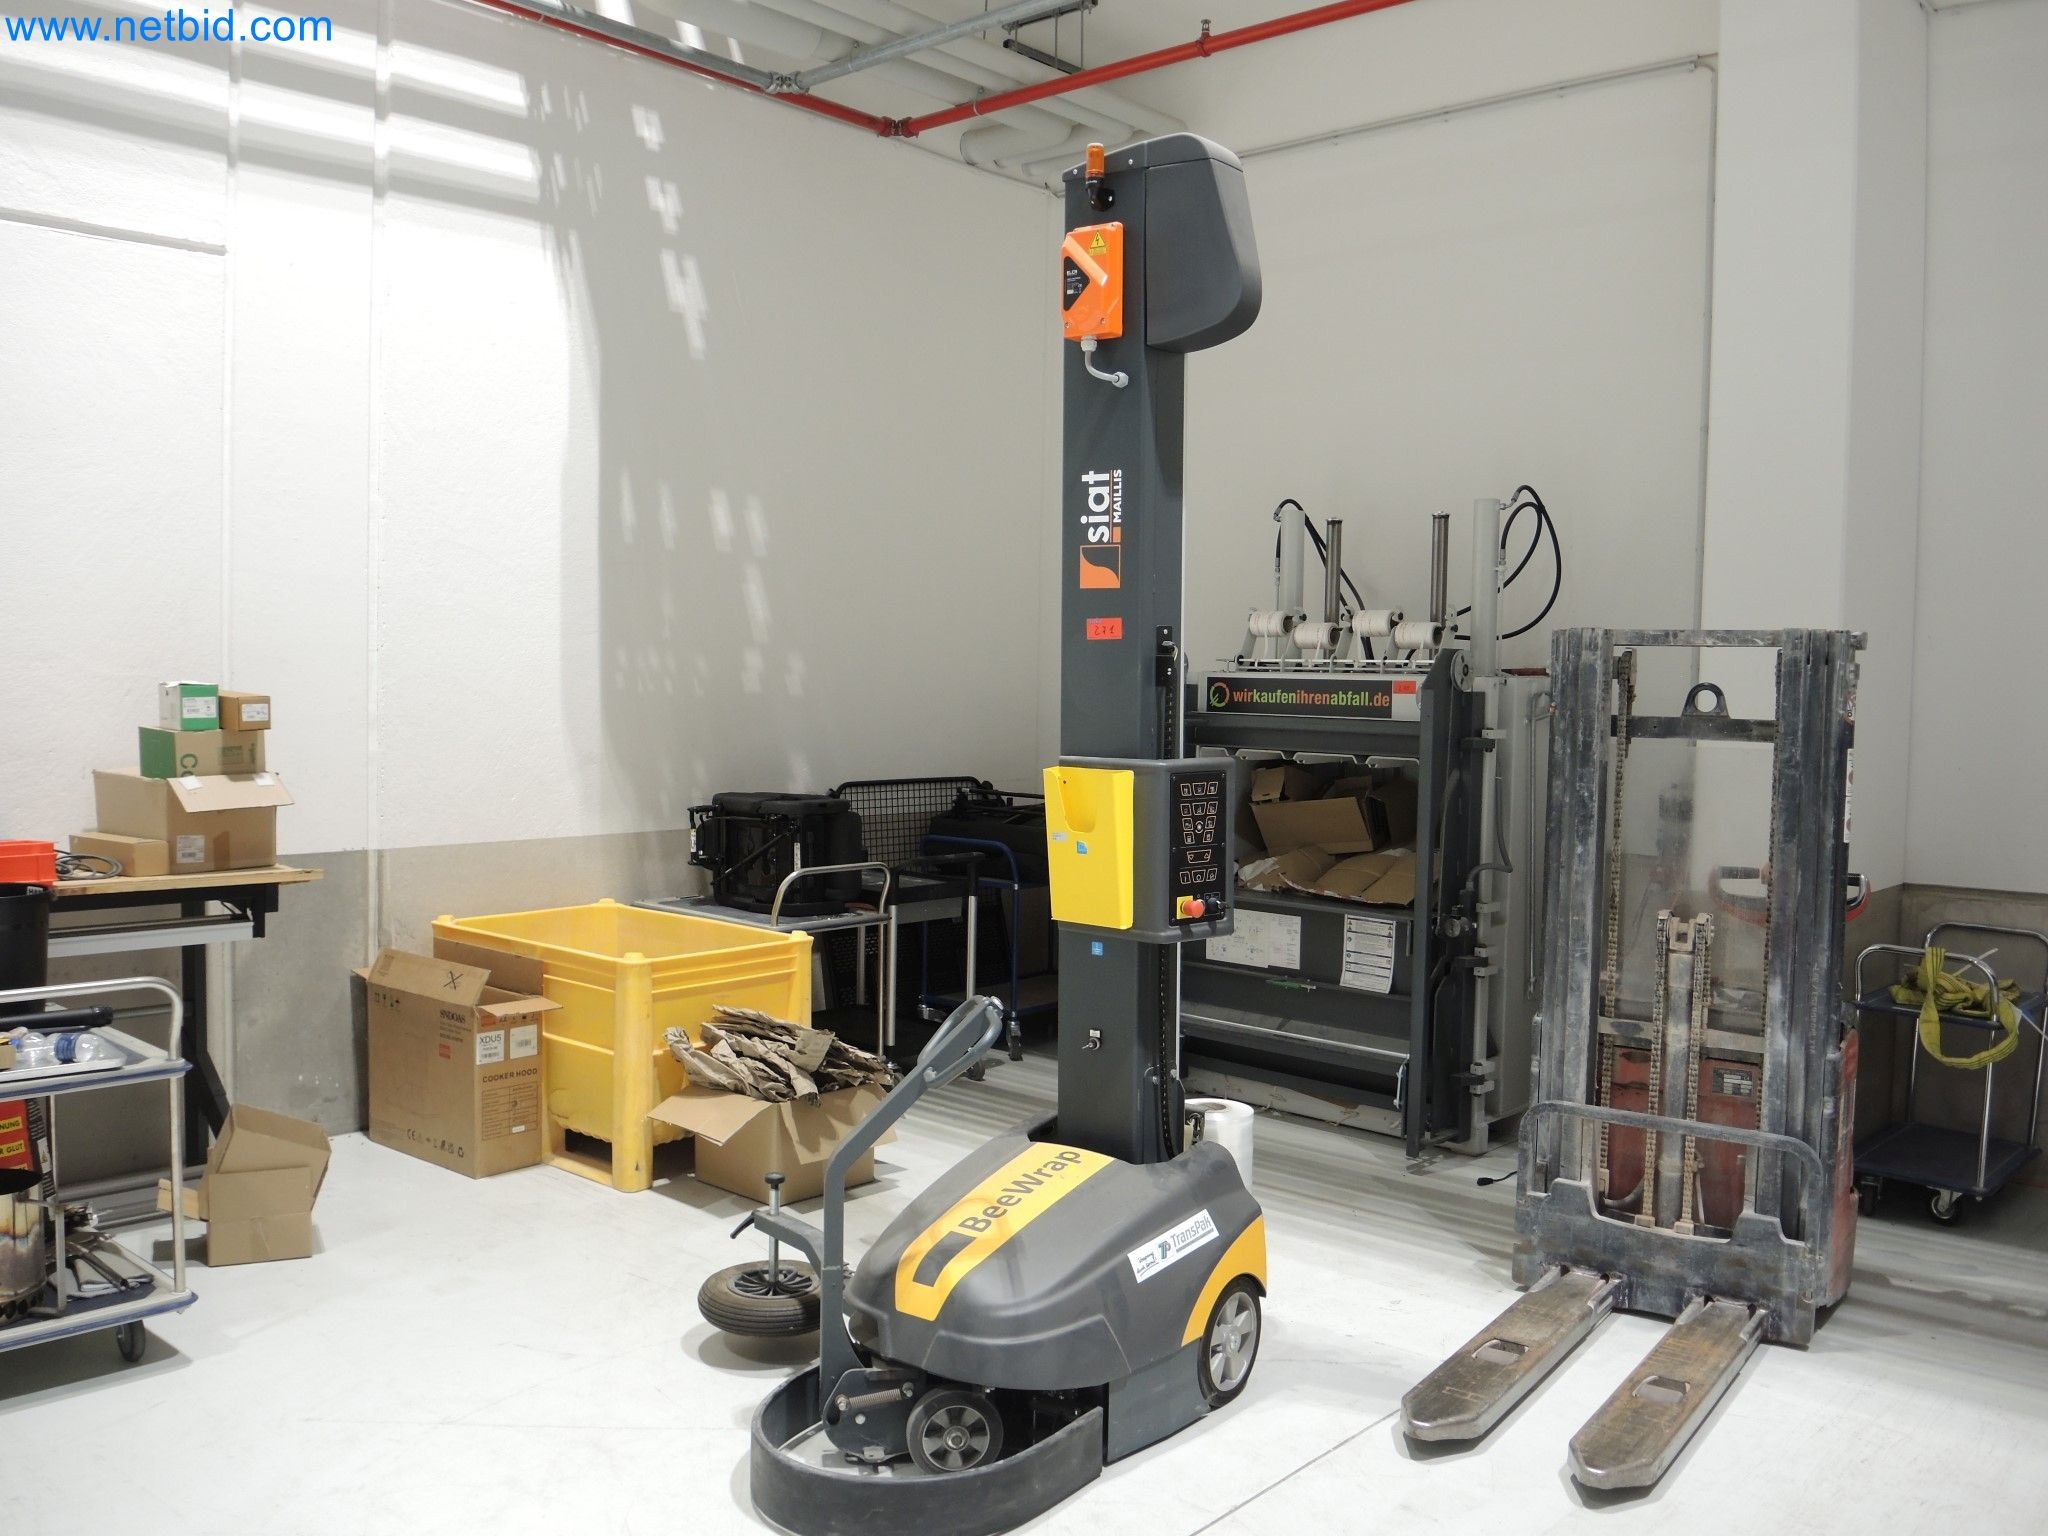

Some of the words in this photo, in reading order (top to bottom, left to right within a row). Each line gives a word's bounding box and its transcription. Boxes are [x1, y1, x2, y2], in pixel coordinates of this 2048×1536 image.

[1081, 470, 1110, 543] siat
[1113, 469, 1122, 523] MAILLIS
[1233, 688, 1390, 707] wirkaufenihrenabfall.de
[482, 1071, 514, 1083] COOKER
[515, 1068, 538, 1077] HOOD
[958, 1151, 1082, 1233] BeeWrap
[1170, 1215, 1212, 1248] TransPak
